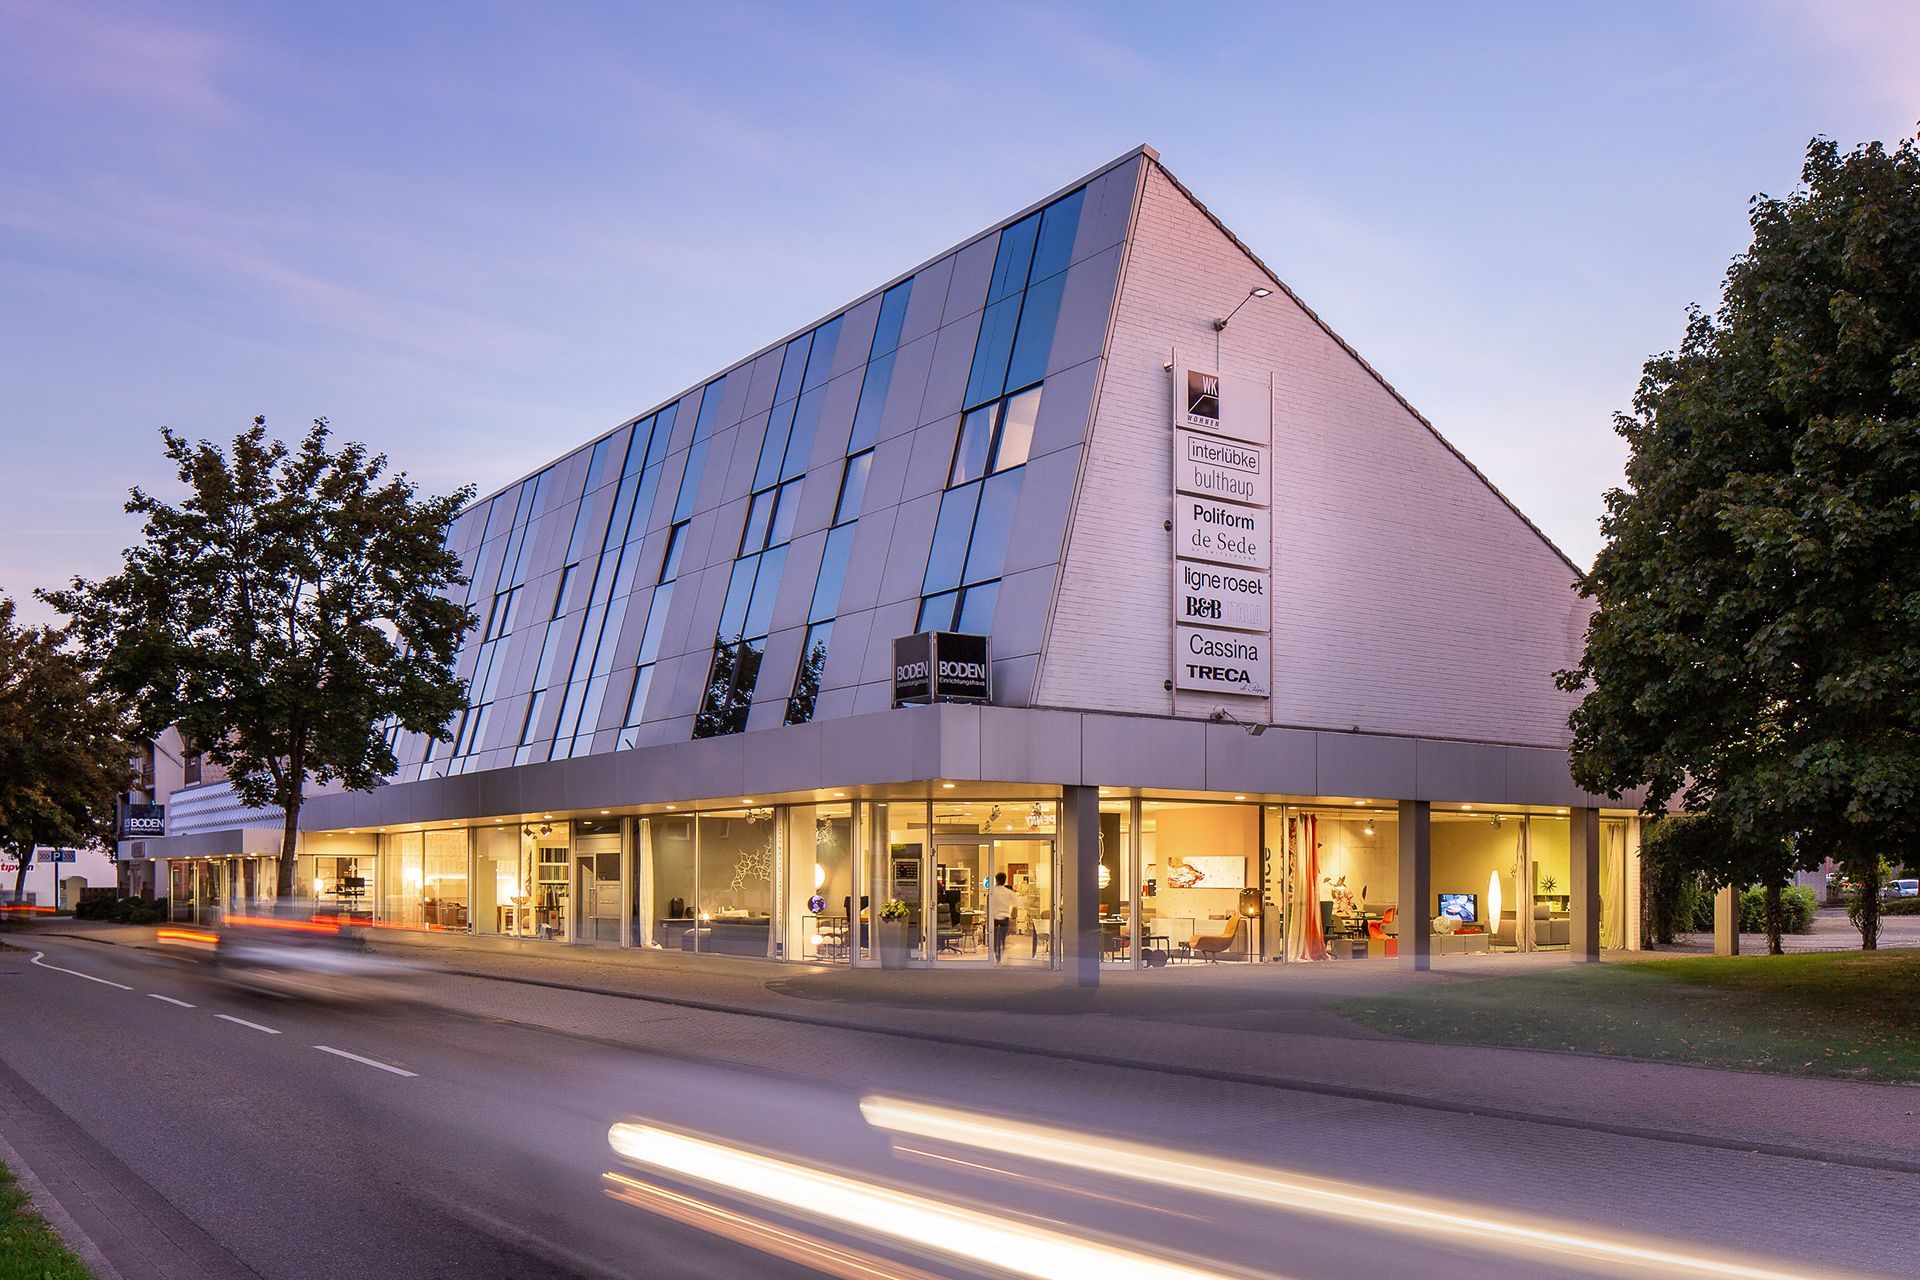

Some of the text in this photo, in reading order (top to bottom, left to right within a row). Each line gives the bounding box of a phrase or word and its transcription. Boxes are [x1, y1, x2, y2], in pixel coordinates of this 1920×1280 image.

[1202, 375, 1218, 396] WK
[1187, 414, 1219, 428] WOHNEN
[1192, 441, 1256, 469] interlübke
[1194, 466, 1254, 501] bulthaup
[1193, 504, 1255, 531] Poliform
[1192, 529, 1211, 548] de
[1217, 532, 1257, 555] Sede
[1184, 566, 1264, 595] ligne roset
[1186, 596, 1263, 625] B&B ITALIA
[1190, 634, 1258, 661] Cassina
[897, 662, 929, 680] BODEN
[939, 661, 985, 679] BODEN
[1186, 664, 1250, 683] TRECA
[939, 677, 985, 687] Einrichtungshaus
[131, 818, 164, 828] BODEN
[54, 851, 61, 861] P
